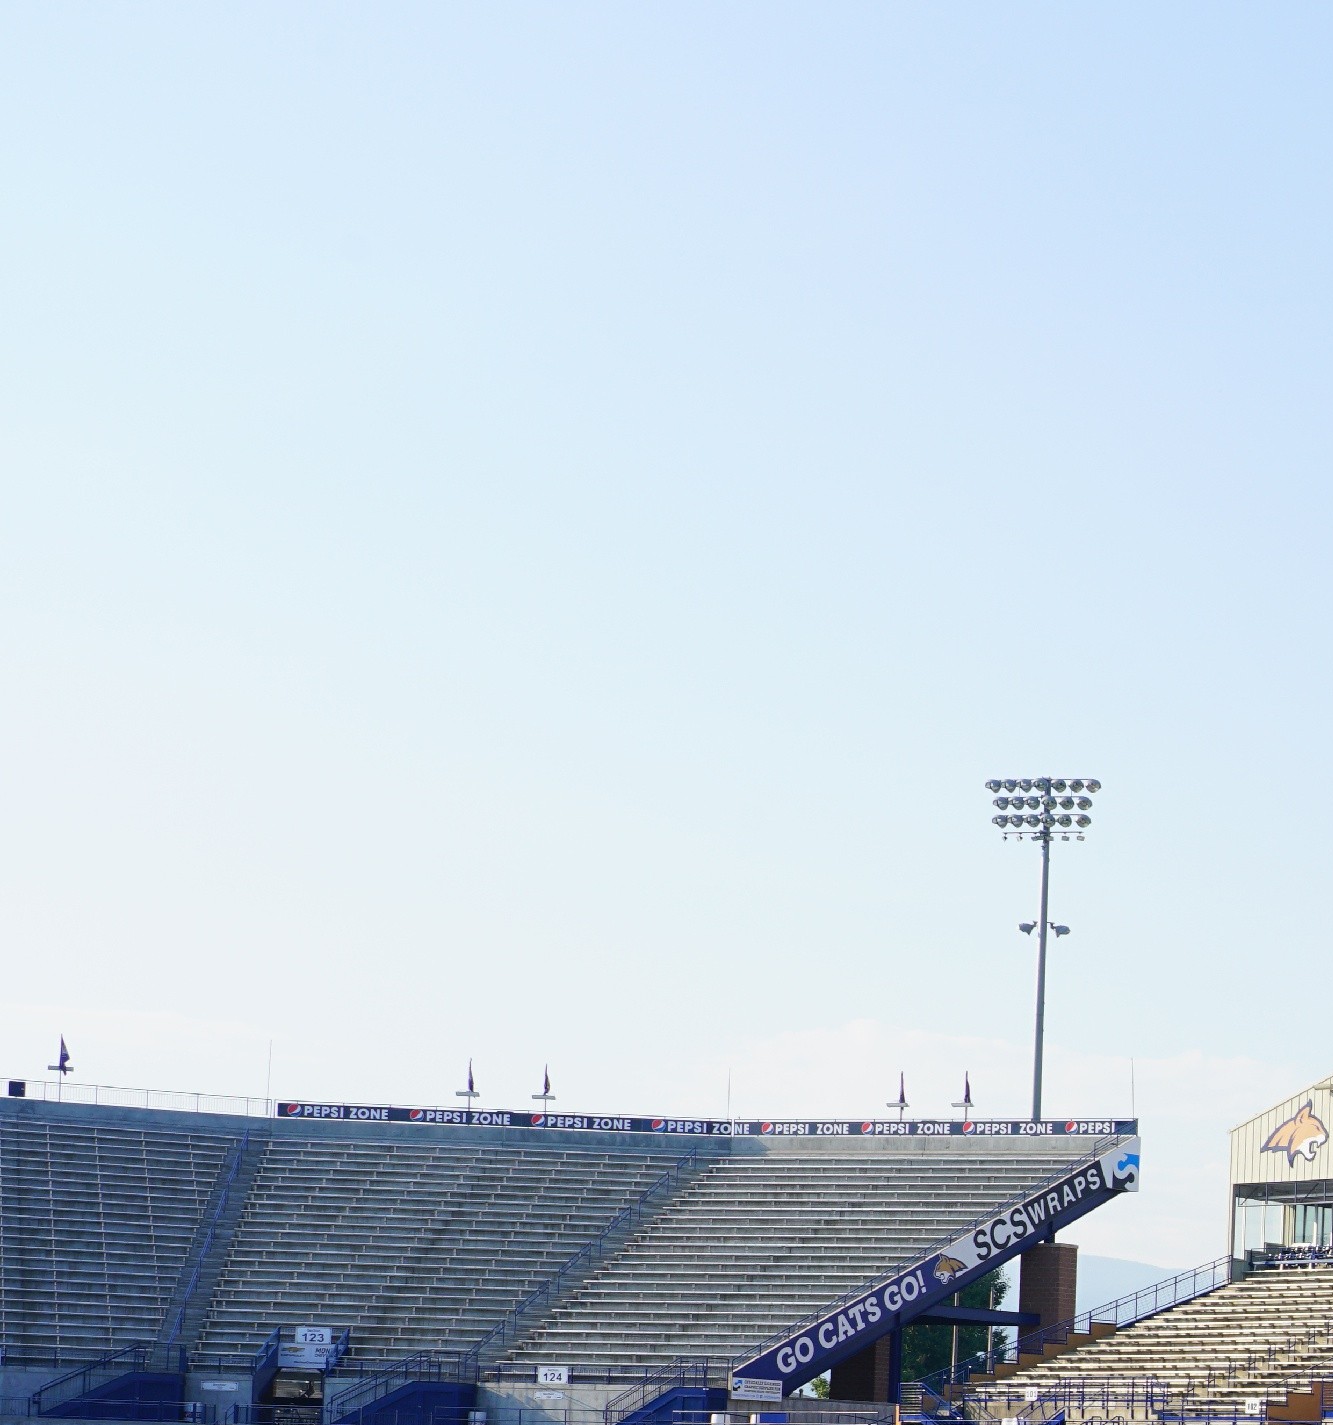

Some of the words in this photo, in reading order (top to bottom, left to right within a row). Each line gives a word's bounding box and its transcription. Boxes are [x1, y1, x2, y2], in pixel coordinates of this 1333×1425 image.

[303, 1106, 344, 1118] PEPSI
[349, 1108, 389, 1120] ZONE
[427, 1111, 466, 1123] PEPSI
[471, 1113, 511, 1125] ZONE
[547, 1116, 587, 1128] PEPSI
[592, 1118, 631, 1130] ZONE
[667, 1122, 707, 1133] PEPSI
[712, 1123, 750, 1135] ZONE
[775, 1123, 809, 1134] PEPSI
[816, 1123, 849, 1134] ZONE
[875, 1123, 909, 1134] PEPSI
[917, 1123, 950, 1134] ZONE
[976, 1123, 1012, 1134] PEPSI
[1019, 1123, 1053, 1134] ZONE
[1079, 1122, 1115, 1134] PEPSI
[776, 1336, 814, 1373] GO
[818, 1296, 882, 1349] CATS
[884, 1270, 927, 1312] GO!
[302, 1333, 324, 1342] 123
[543, 1372, 562, 1382] 124
